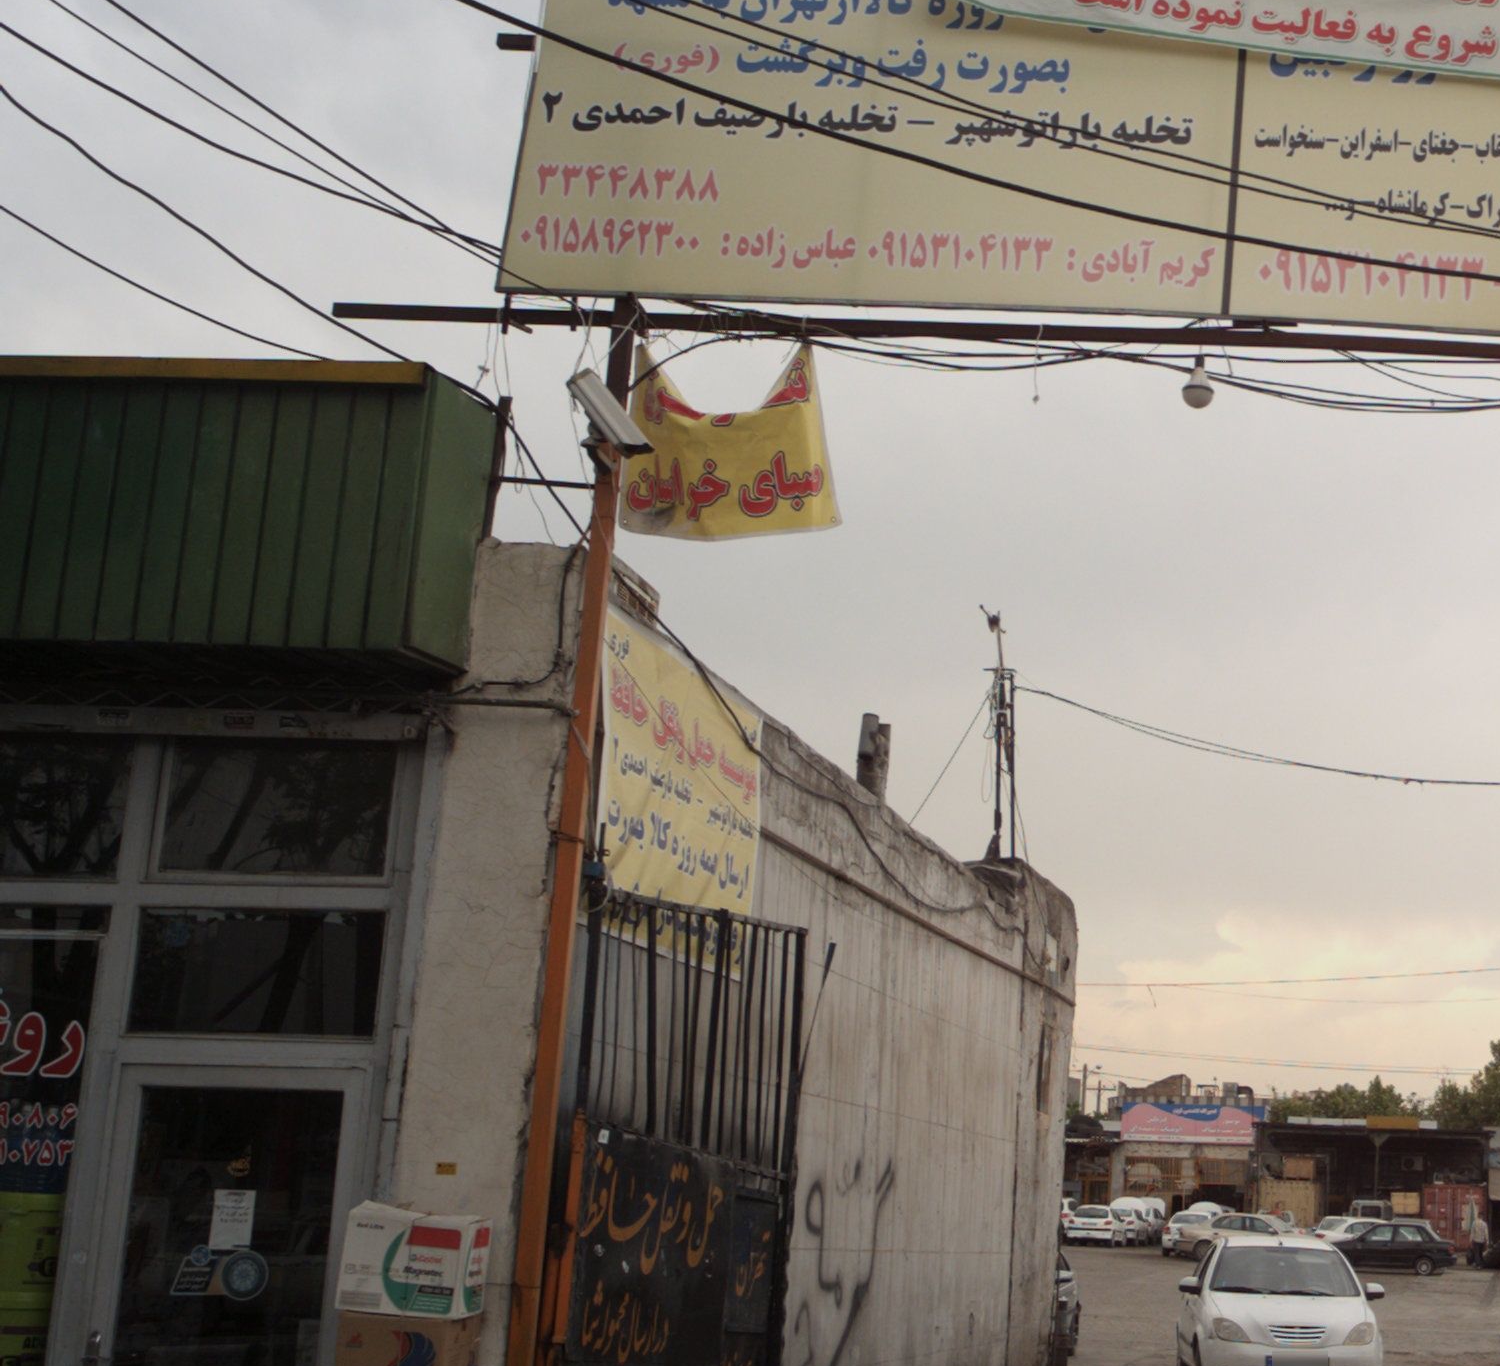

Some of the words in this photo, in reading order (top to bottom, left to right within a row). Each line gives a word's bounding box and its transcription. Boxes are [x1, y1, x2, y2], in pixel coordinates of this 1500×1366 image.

[1250, 6, 1356, 44] فعالیت
[1364, 22, 1396, 57] به
[1404, 24, 1497, 65] شروع
[878, 39, 946, 90] رفت
[957, 50, 1070, 94] بصورت
[543, 92, 564, 124] ۲
[572, 98, 685, 132] احمدی
[818, 102, 898, 138] تخلیه
[1112, 115, 1193, 150] تخلیه
[538, 162, 719, 203] ۳۳۴۴۸۳۸۸
[520, 214, 700, 257] ۰۹۱۵۸۹۶۲۳۰۰
[792, 228, 857, 269] عباس
[867, 229, 1053, 273] ۰۹۱۵۳۱۰۴۱۳۳
[1157, 246, 1214, 288] کریم
